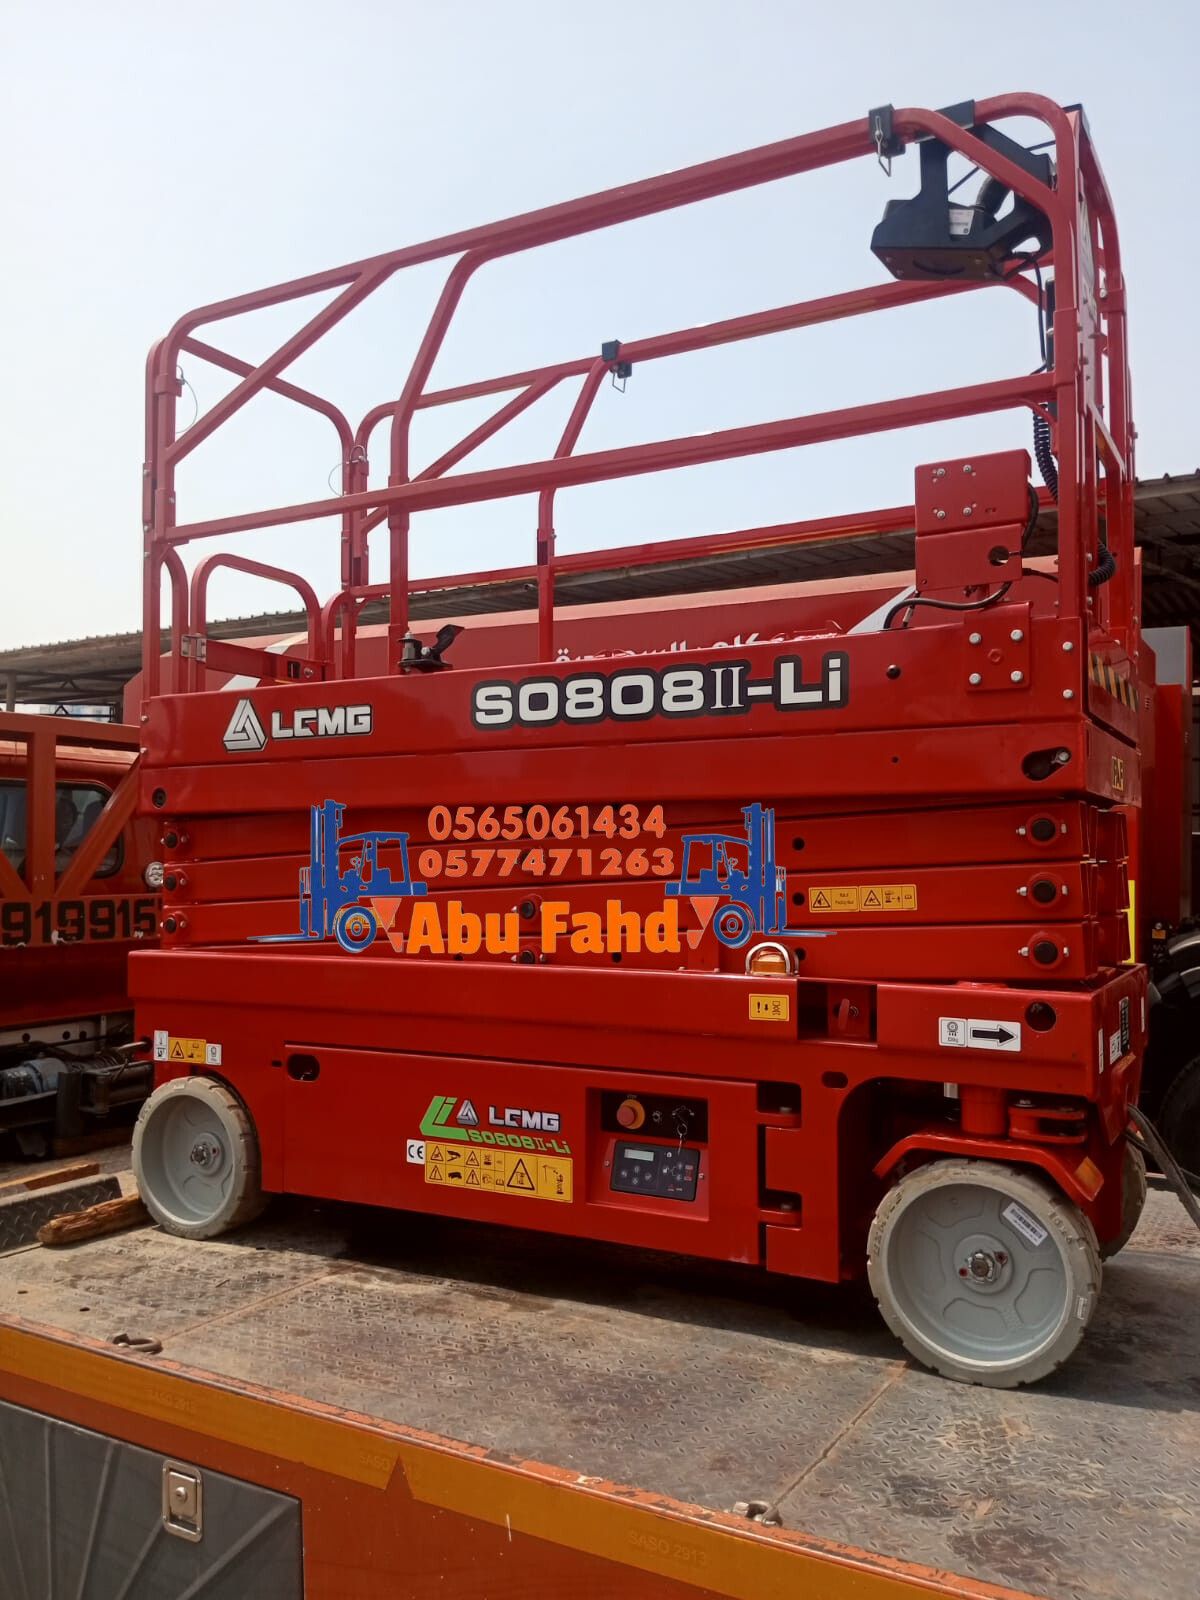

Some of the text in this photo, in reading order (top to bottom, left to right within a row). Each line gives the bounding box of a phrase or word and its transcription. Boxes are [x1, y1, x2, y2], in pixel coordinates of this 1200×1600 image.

[271, 704, 371, 739] LGMG
[2, 898, 162, 946] 919915
[489, 1105, 560, 1132] LGMG
